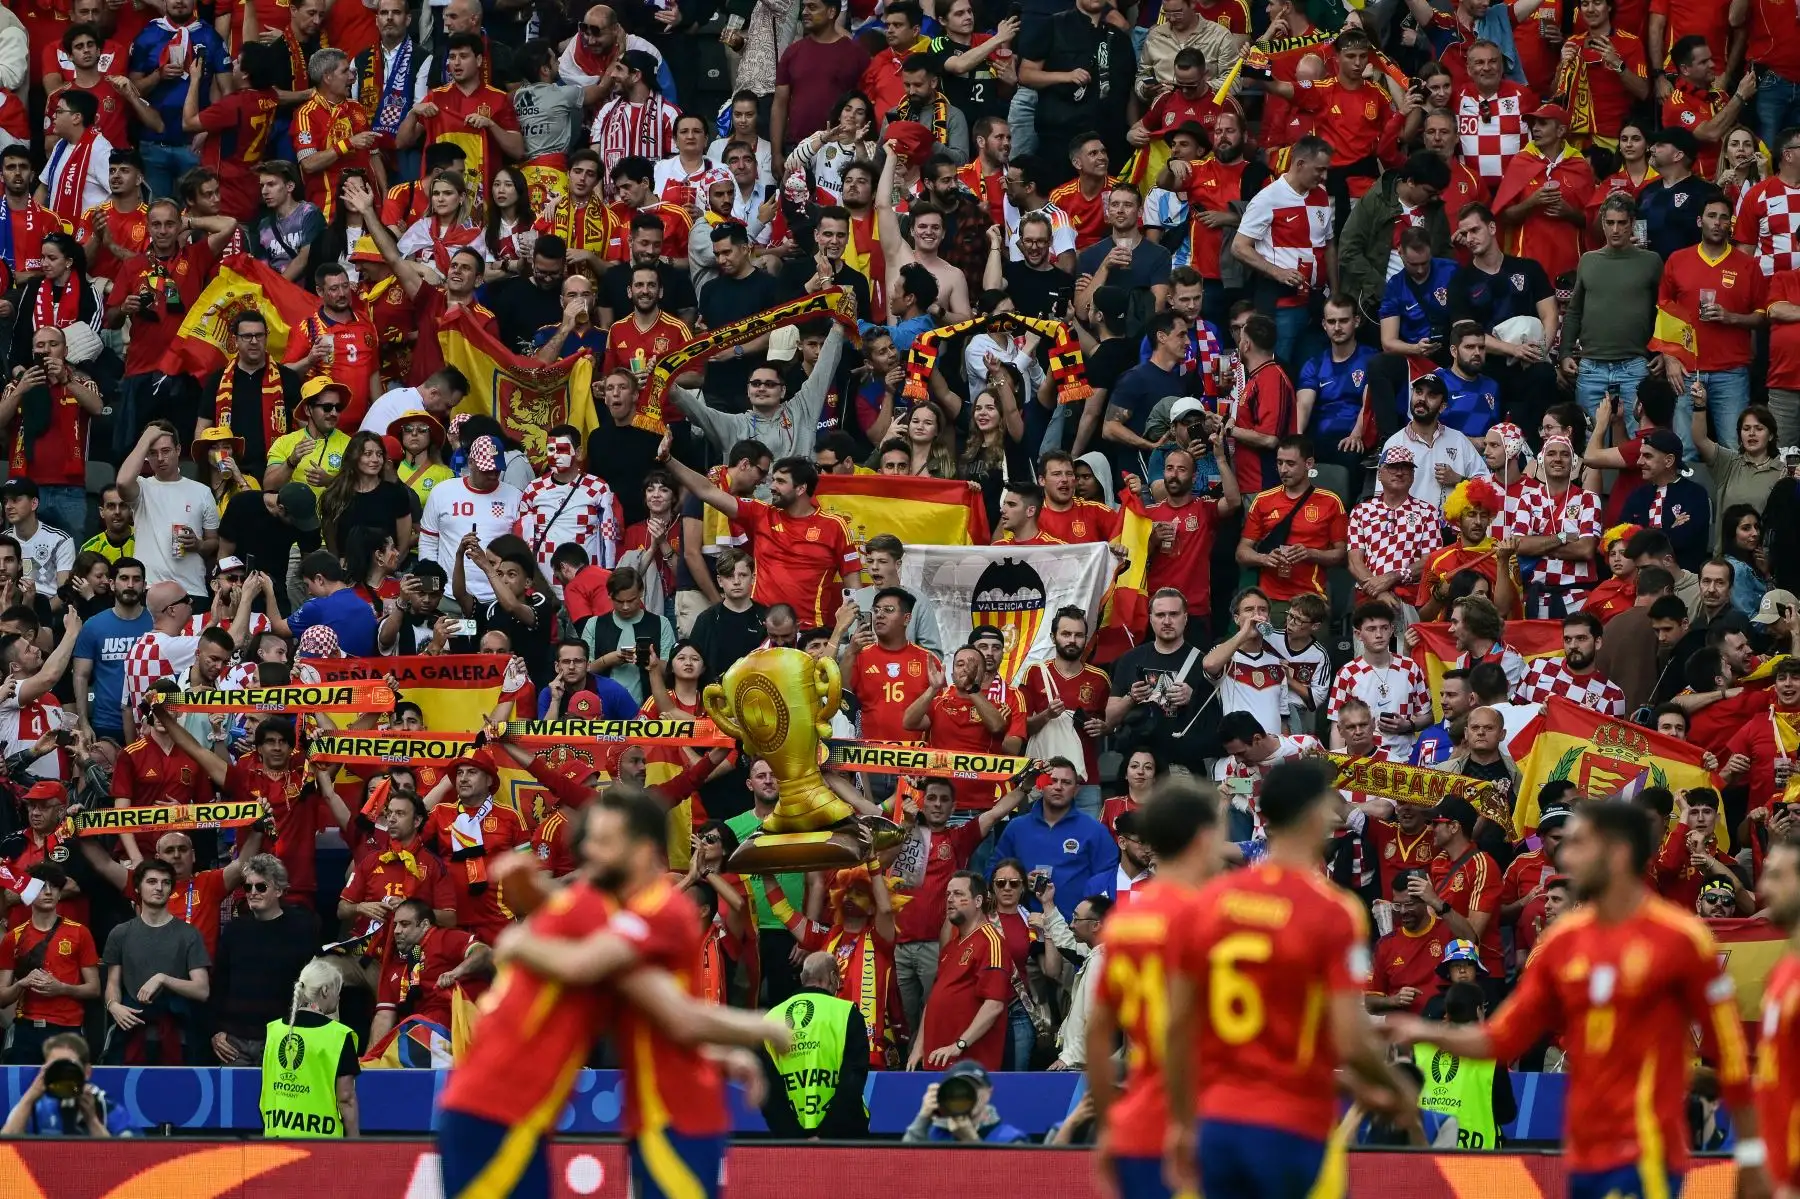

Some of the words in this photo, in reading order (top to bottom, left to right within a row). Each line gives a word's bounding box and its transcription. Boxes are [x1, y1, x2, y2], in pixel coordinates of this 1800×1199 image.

[64, 163, 78, 196] SPAIN
[345, 343, 358, 363] 3
[816, 417, 839, 430] potify
[452, 501, 475, 517] 10
[978, 602, 1024, 612] VALENCIA
[101, 636, 135, 655] JUST
[420, 664, 500, 681] GALERA
[184, 686, 353, 705] MAREAROJA
[882, 681, 906, 703] 16
[255, 703, 285, 712] FANS
[526, 719, 696, 738] MAREAROJA
[595, 734, 626, 743] FANS
[381, 754, 411, 764] FANS
[842, 747, 928, 769] MAREA
[953, 755, 1015, 774] ROJA
[953, 770, 978, 780] FANS
[82, 808, 169, 828] MAREA
[196, 803, 258, 822] ROJA
[196, 821, 221, 829] FANS
[1208, 930, 1275, 1046] 6
